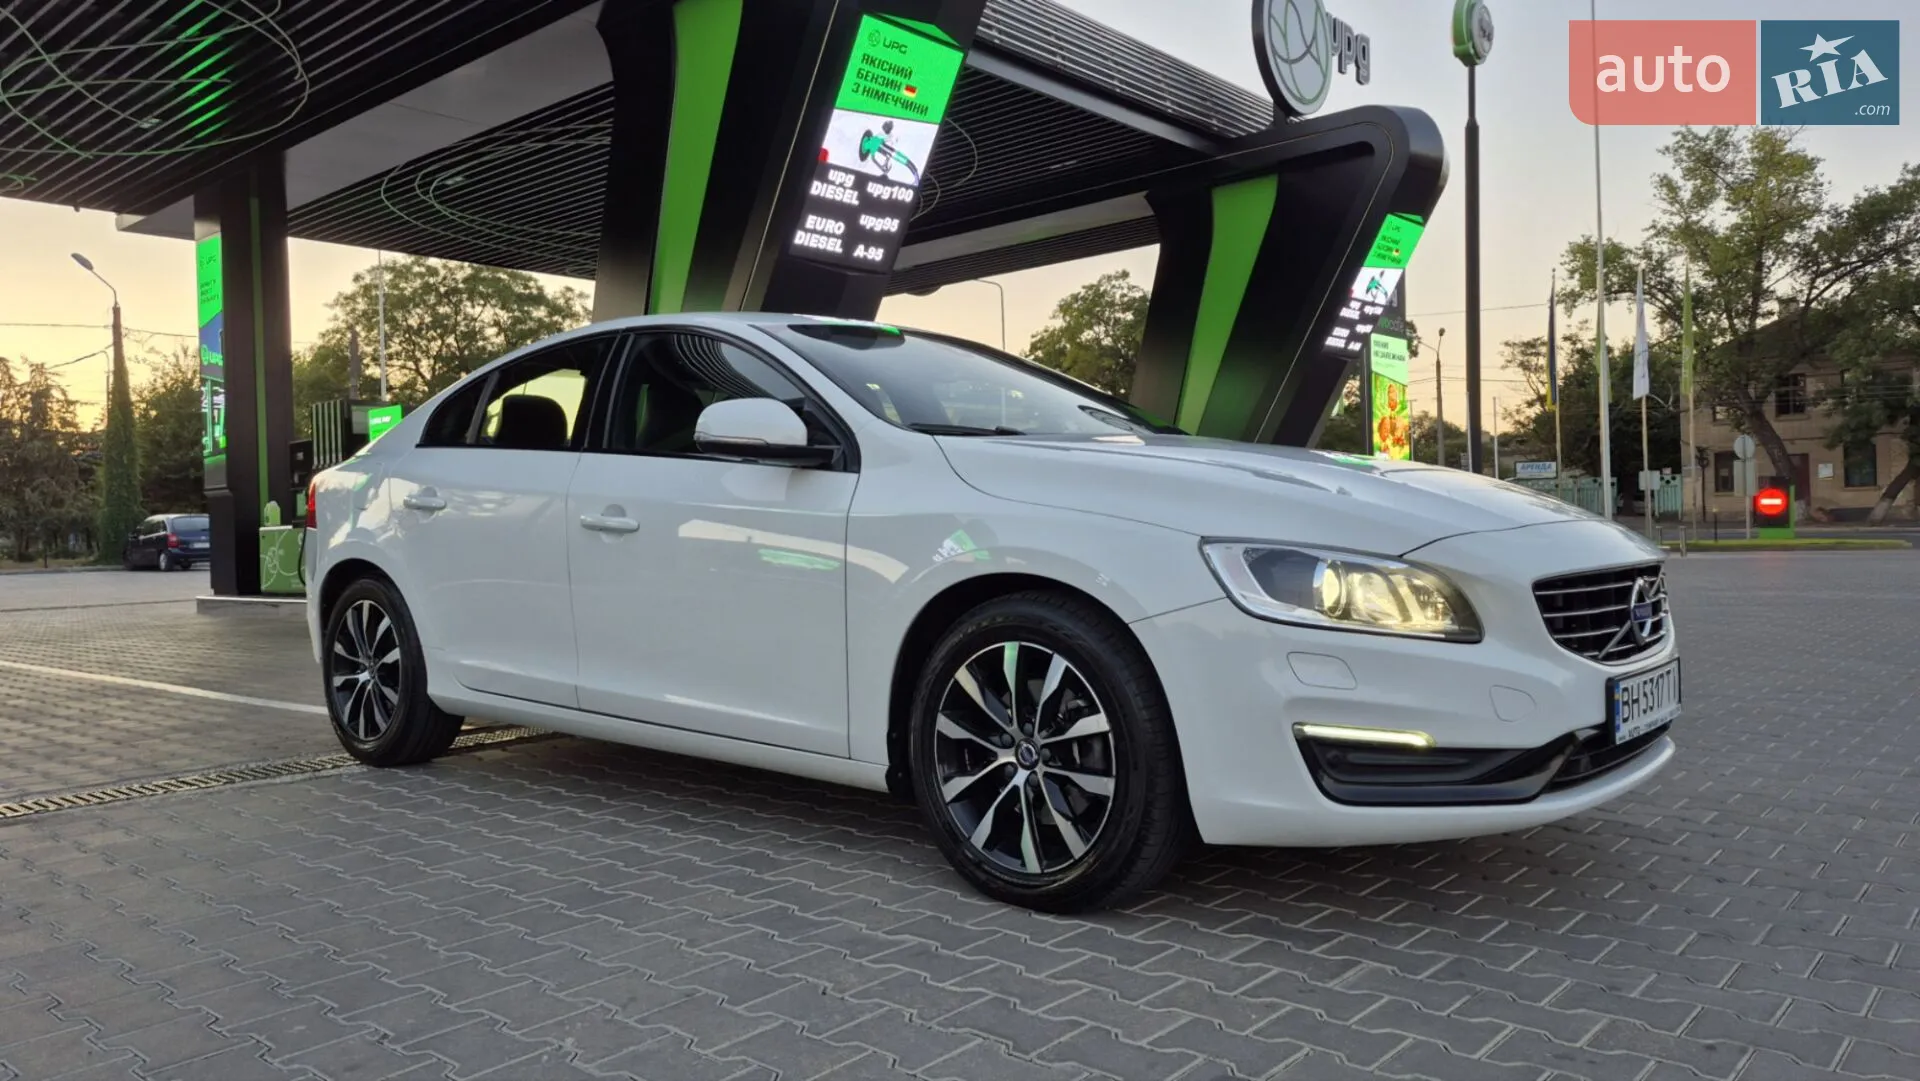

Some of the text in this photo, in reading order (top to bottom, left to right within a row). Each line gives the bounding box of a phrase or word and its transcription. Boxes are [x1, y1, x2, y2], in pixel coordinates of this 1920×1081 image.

[883, 37, 908, 55] UPG
[1327, 11, 1371, 85] upg
[861, 53, 913, 80] ЯКІСНИЙ
[856, 68, 901, 92] БЕНЗИН
[861, 84, 929, 117] НІМЕЧЧИНИ
[828, 169, 855, 187] upg
[810, 180, 860, 206] DIESEL
[867, 181, 914, 203] upg100
[805, 214, 846, 235] EURO
[859, 214, 900, 233] upg95
[794, 230, 844, 254] DIESEL
[853, 244, 884, 262] A-95
[1621, 681, 1641, 724] BH
[1642, 672, 1665, 715] 5317
